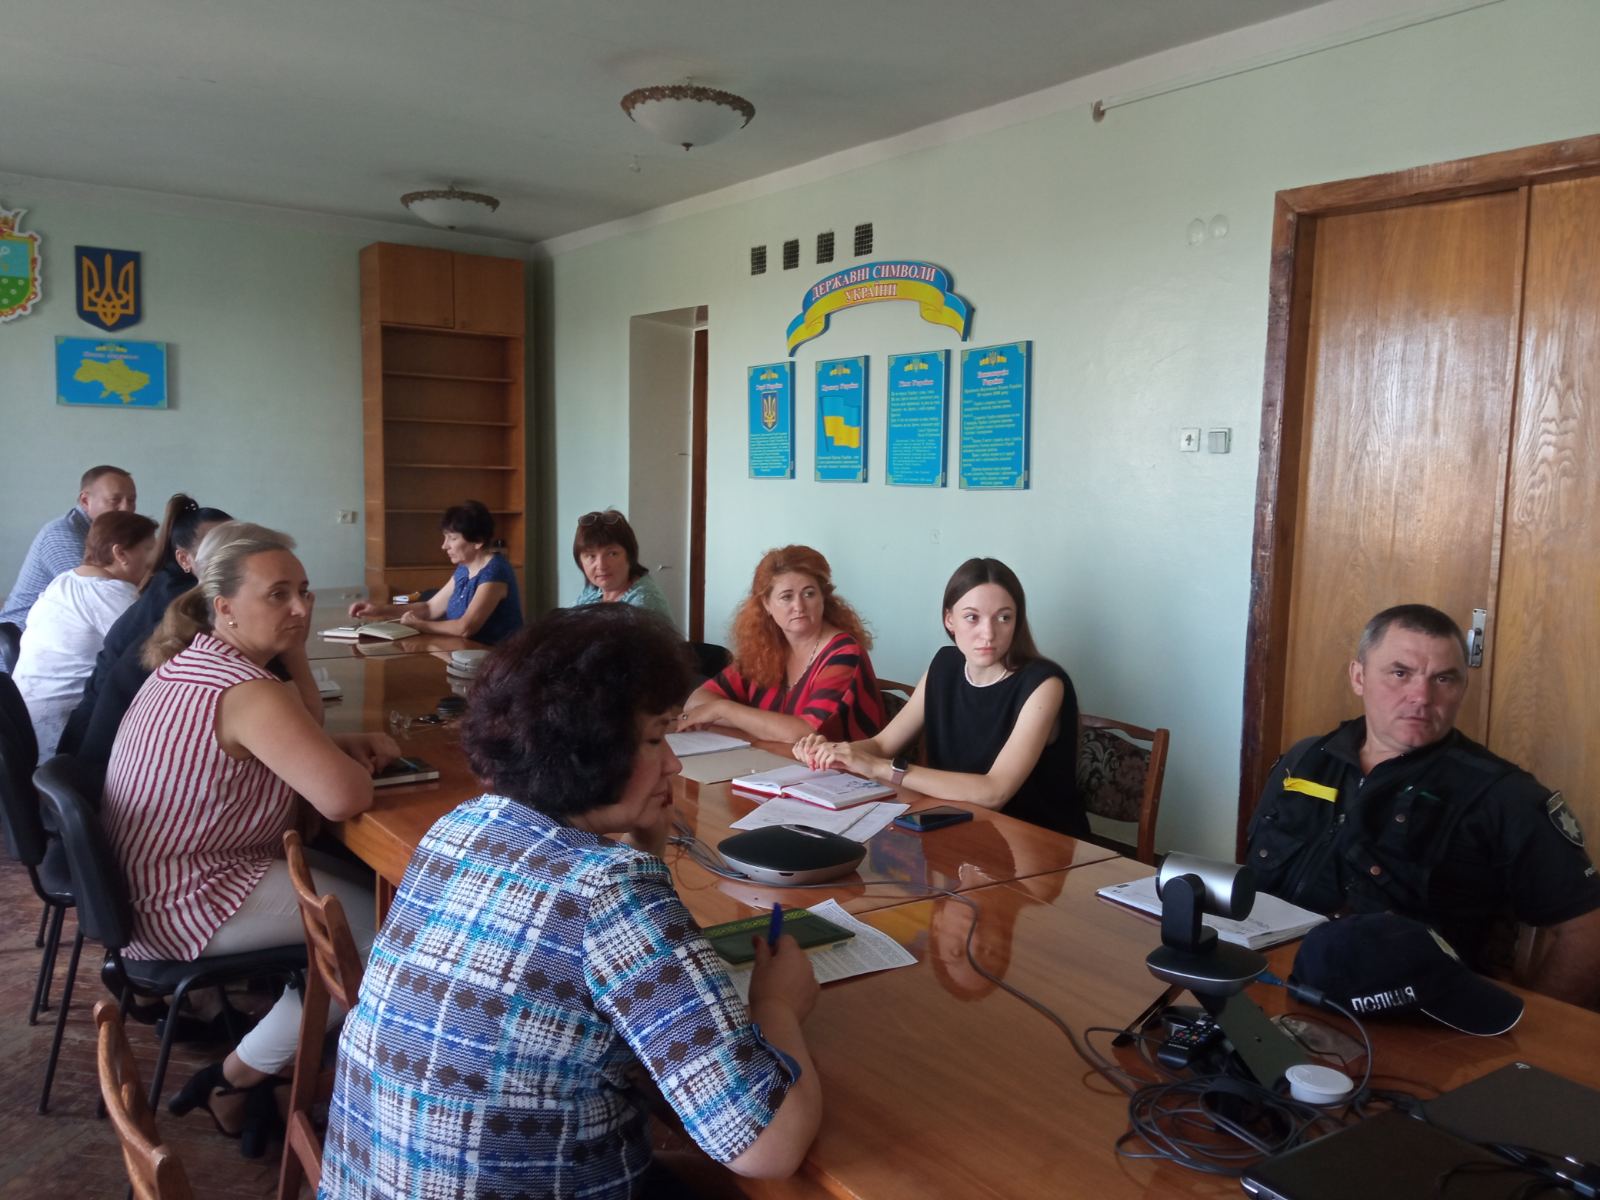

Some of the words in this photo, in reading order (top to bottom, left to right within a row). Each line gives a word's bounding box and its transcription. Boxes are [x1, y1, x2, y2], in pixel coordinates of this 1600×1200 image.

[812, 267, 869, 300] ДЕРЖАВНІ
[872, 264, 937, 282] СИМВОЛИ
[845, 281, 898, 303] УКРАЇНИ
